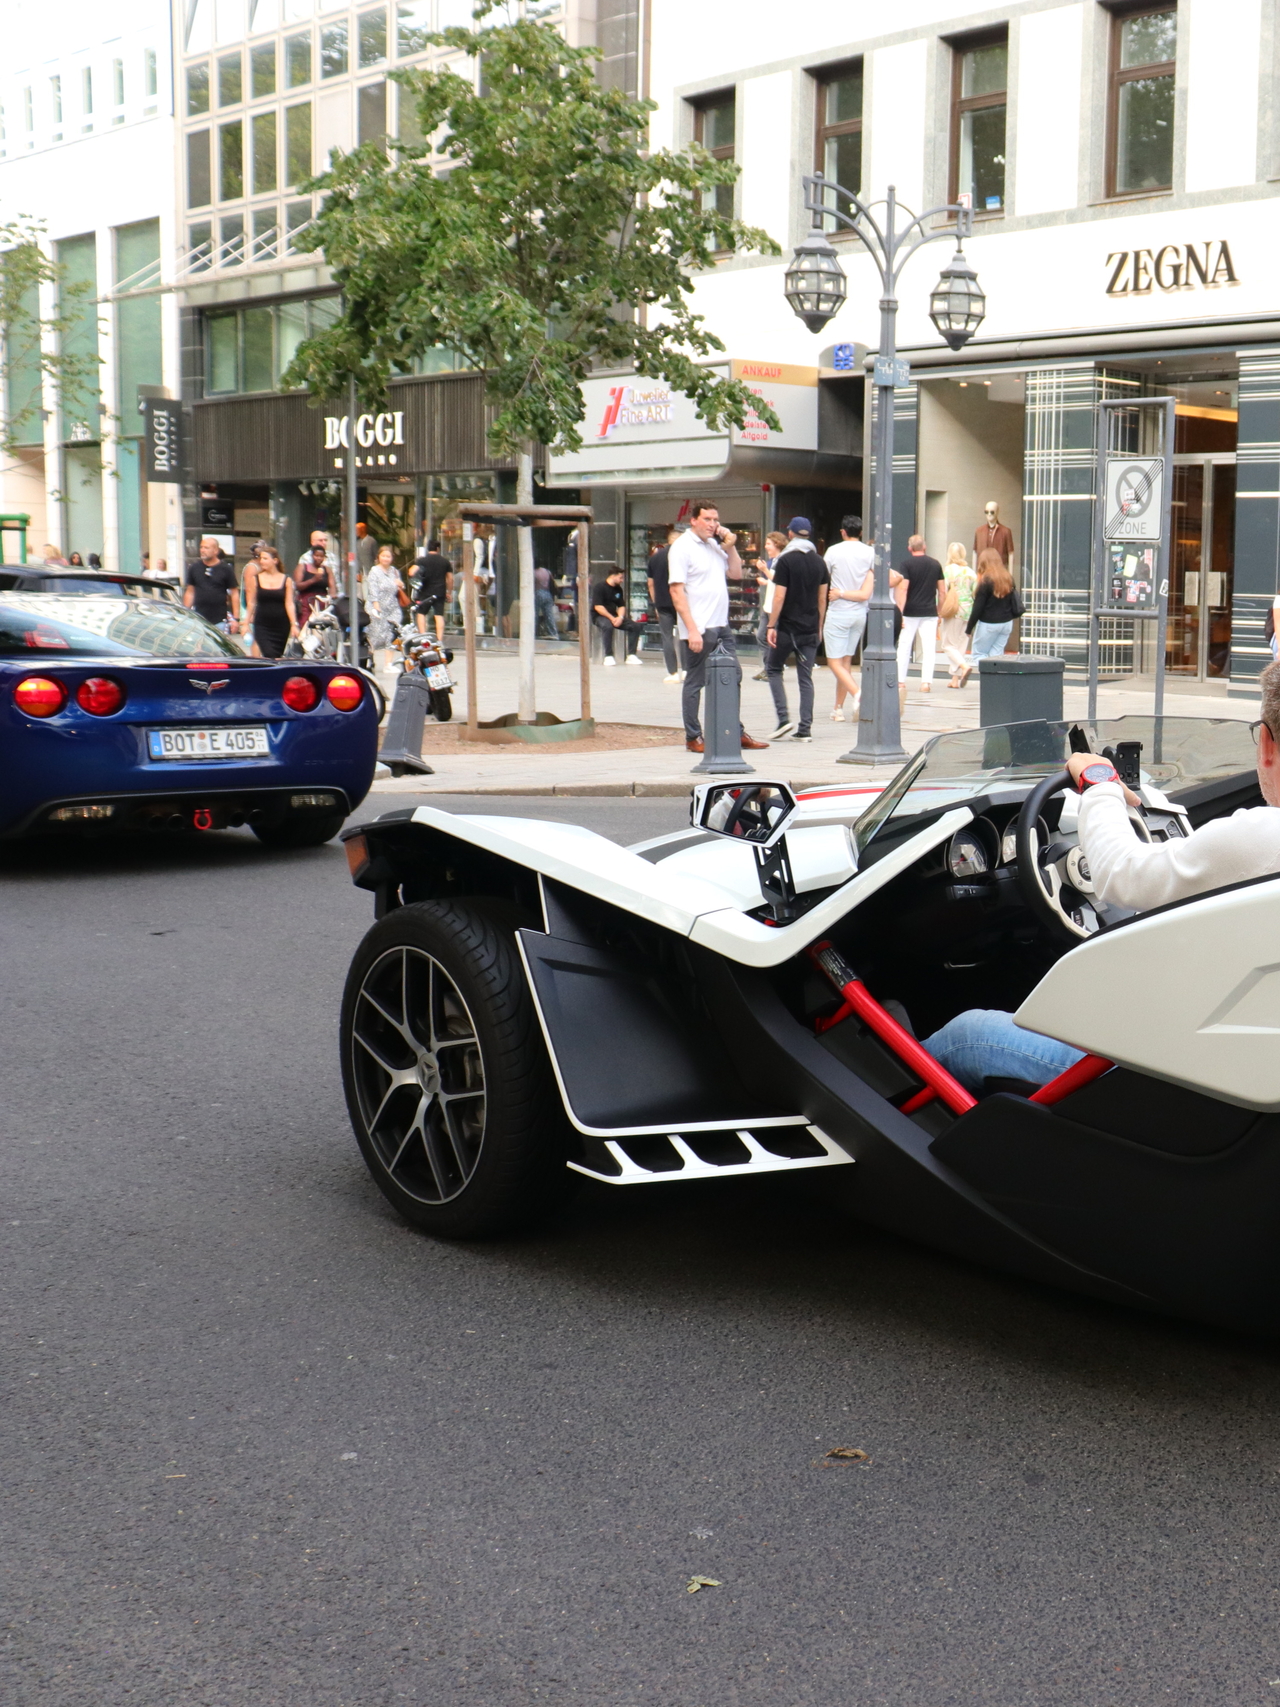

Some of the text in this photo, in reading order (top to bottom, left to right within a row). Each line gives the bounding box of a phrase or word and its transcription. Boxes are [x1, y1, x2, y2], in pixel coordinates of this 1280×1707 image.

[1105, 240, 1240, 294] ZEGNA
[741, 365, 782, 378] ANKAUF
[629, 388, 671, 404] Juwelier
[621, 403, 671, 423] Fine ART
[153, 408, 170, 472] BOGGI
[741, 431, 768, 441] Altgold
[334, 453, 398, 469] MLANO
[1118, 521, 1147, 535] ZONE
[162, 733, 196, 752] BOT
[208, 732, 221, 751] E
[225, 731, 256, 750] 405
